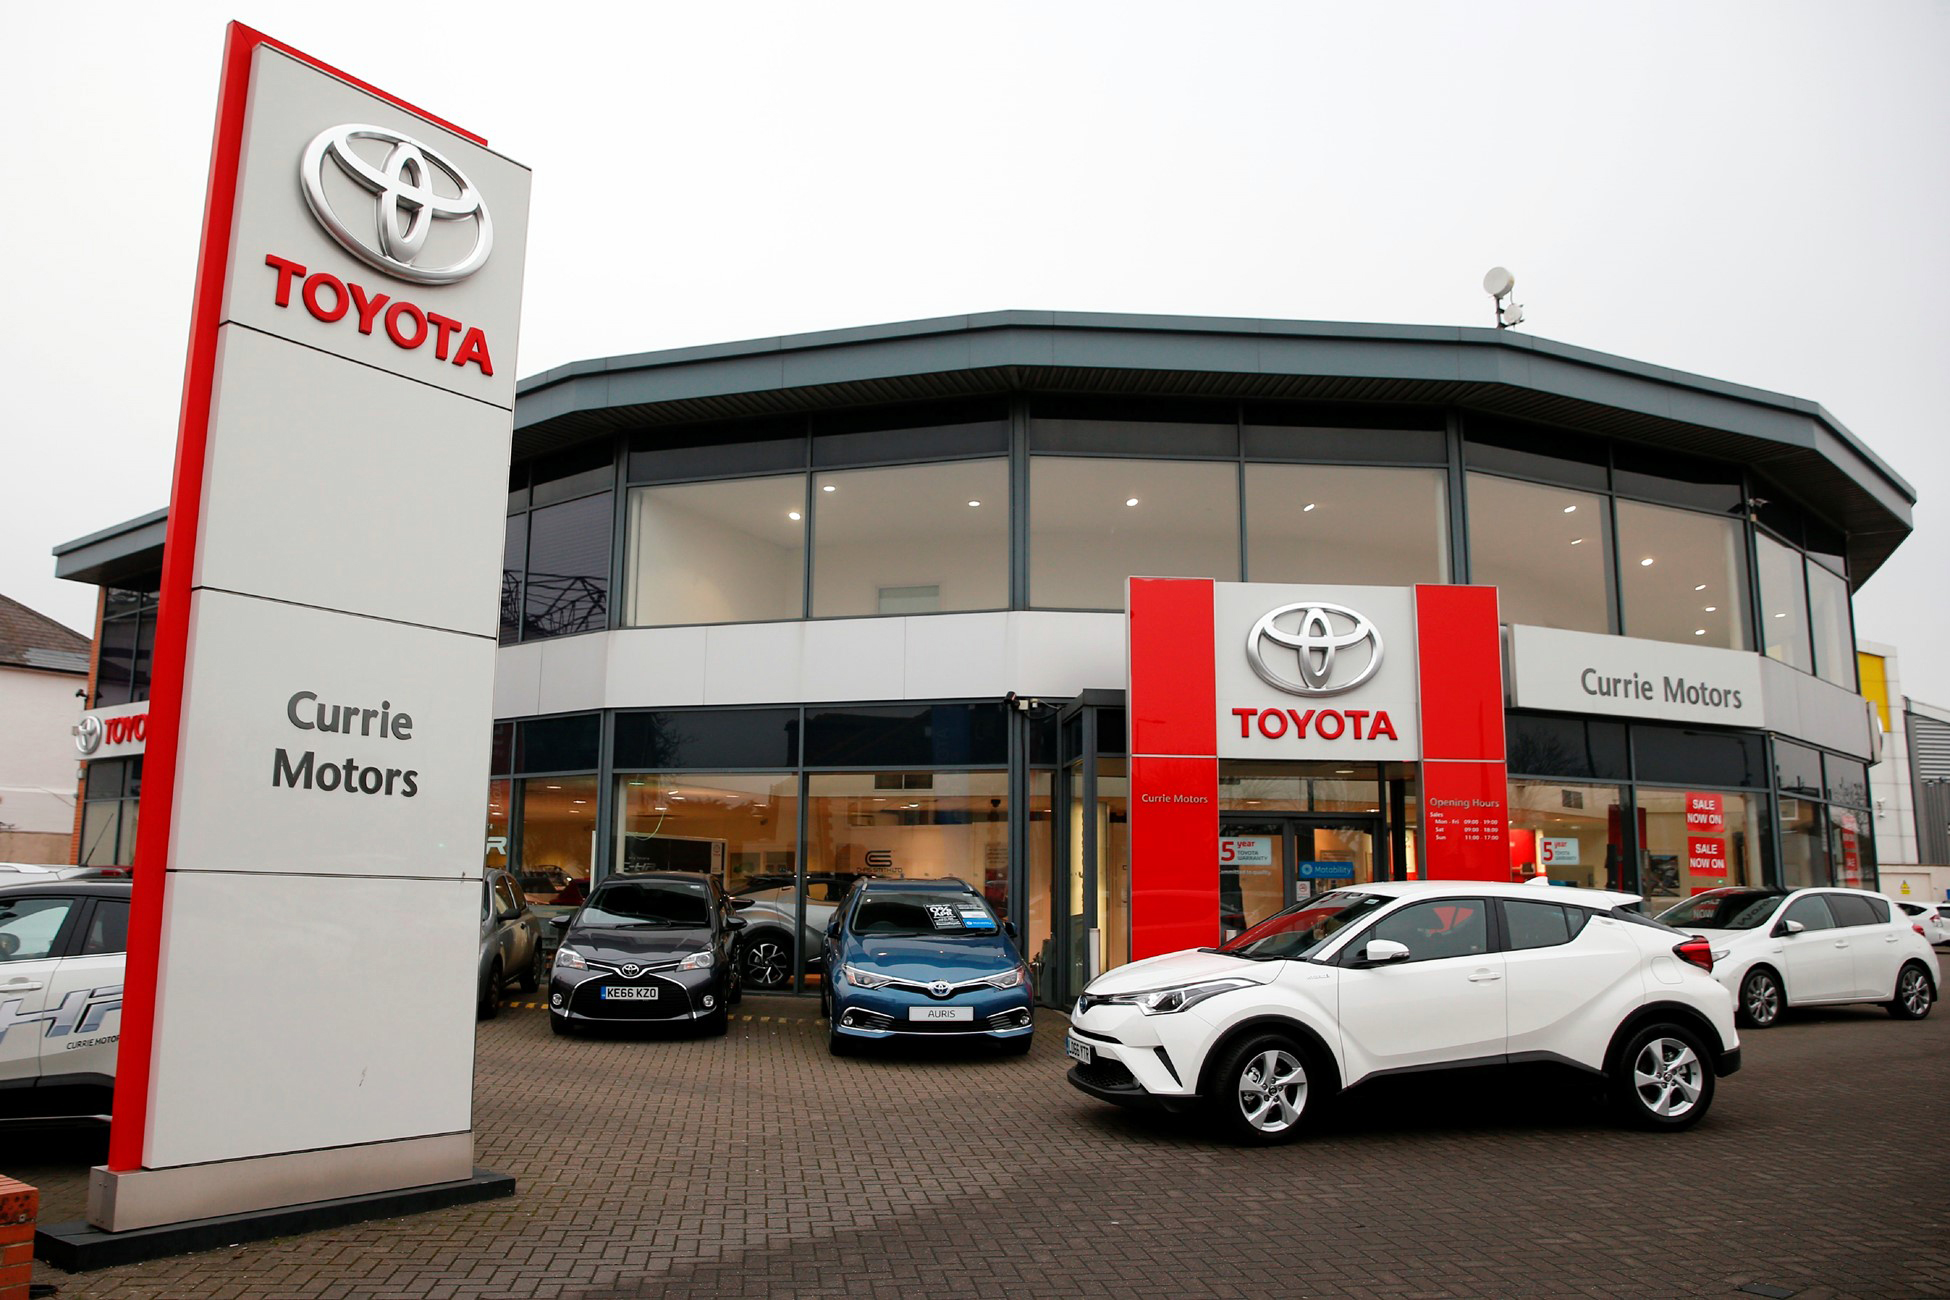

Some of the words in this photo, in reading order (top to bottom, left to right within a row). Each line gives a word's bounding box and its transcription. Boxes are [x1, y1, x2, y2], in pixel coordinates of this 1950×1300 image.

[265, 254, 494, 377] TOYOTA
[1581, 668, 1653, 701] Currie
[1663, 676, 1742, 709] Motors
[287, 690, 413, 741] Currie
[105, 713, 147, 745] TOYO
[1232, 708, 1398, 741] TOYOTA
[272, 747, 419, 798] Motors
[1141, 793, 1171, 803] Currie
[1173, 794, 1209, 804] Motors
[1429, 797, 1470, 809] Opening
[1472, 798, 1500, 808] Hours
[1692, 799, 1715, 810] SALE
[1687, 813, 1708, 824] NOW
[1708, 814, 1722, 825] ON
[1221, 841, 1235, 861] 5
[1237, 841, 1255, 849] year
[1543, 841, 1553, 861] 5
[1695, 843, 1718, 855] SALE
[1689, 857, 1710, 868] NOW
[1711, 858, 1725, 869] ON
[1315, 865, 1351, 876] Motability
[607, 988, 634, 998] KE66
[636, 988, 657, 998] KZO
[927, 1009, 956, 1018] AURIS
[66, 1038, 95, 1050] CURRIE
[94, 1034, 120, 1046] MOTO
